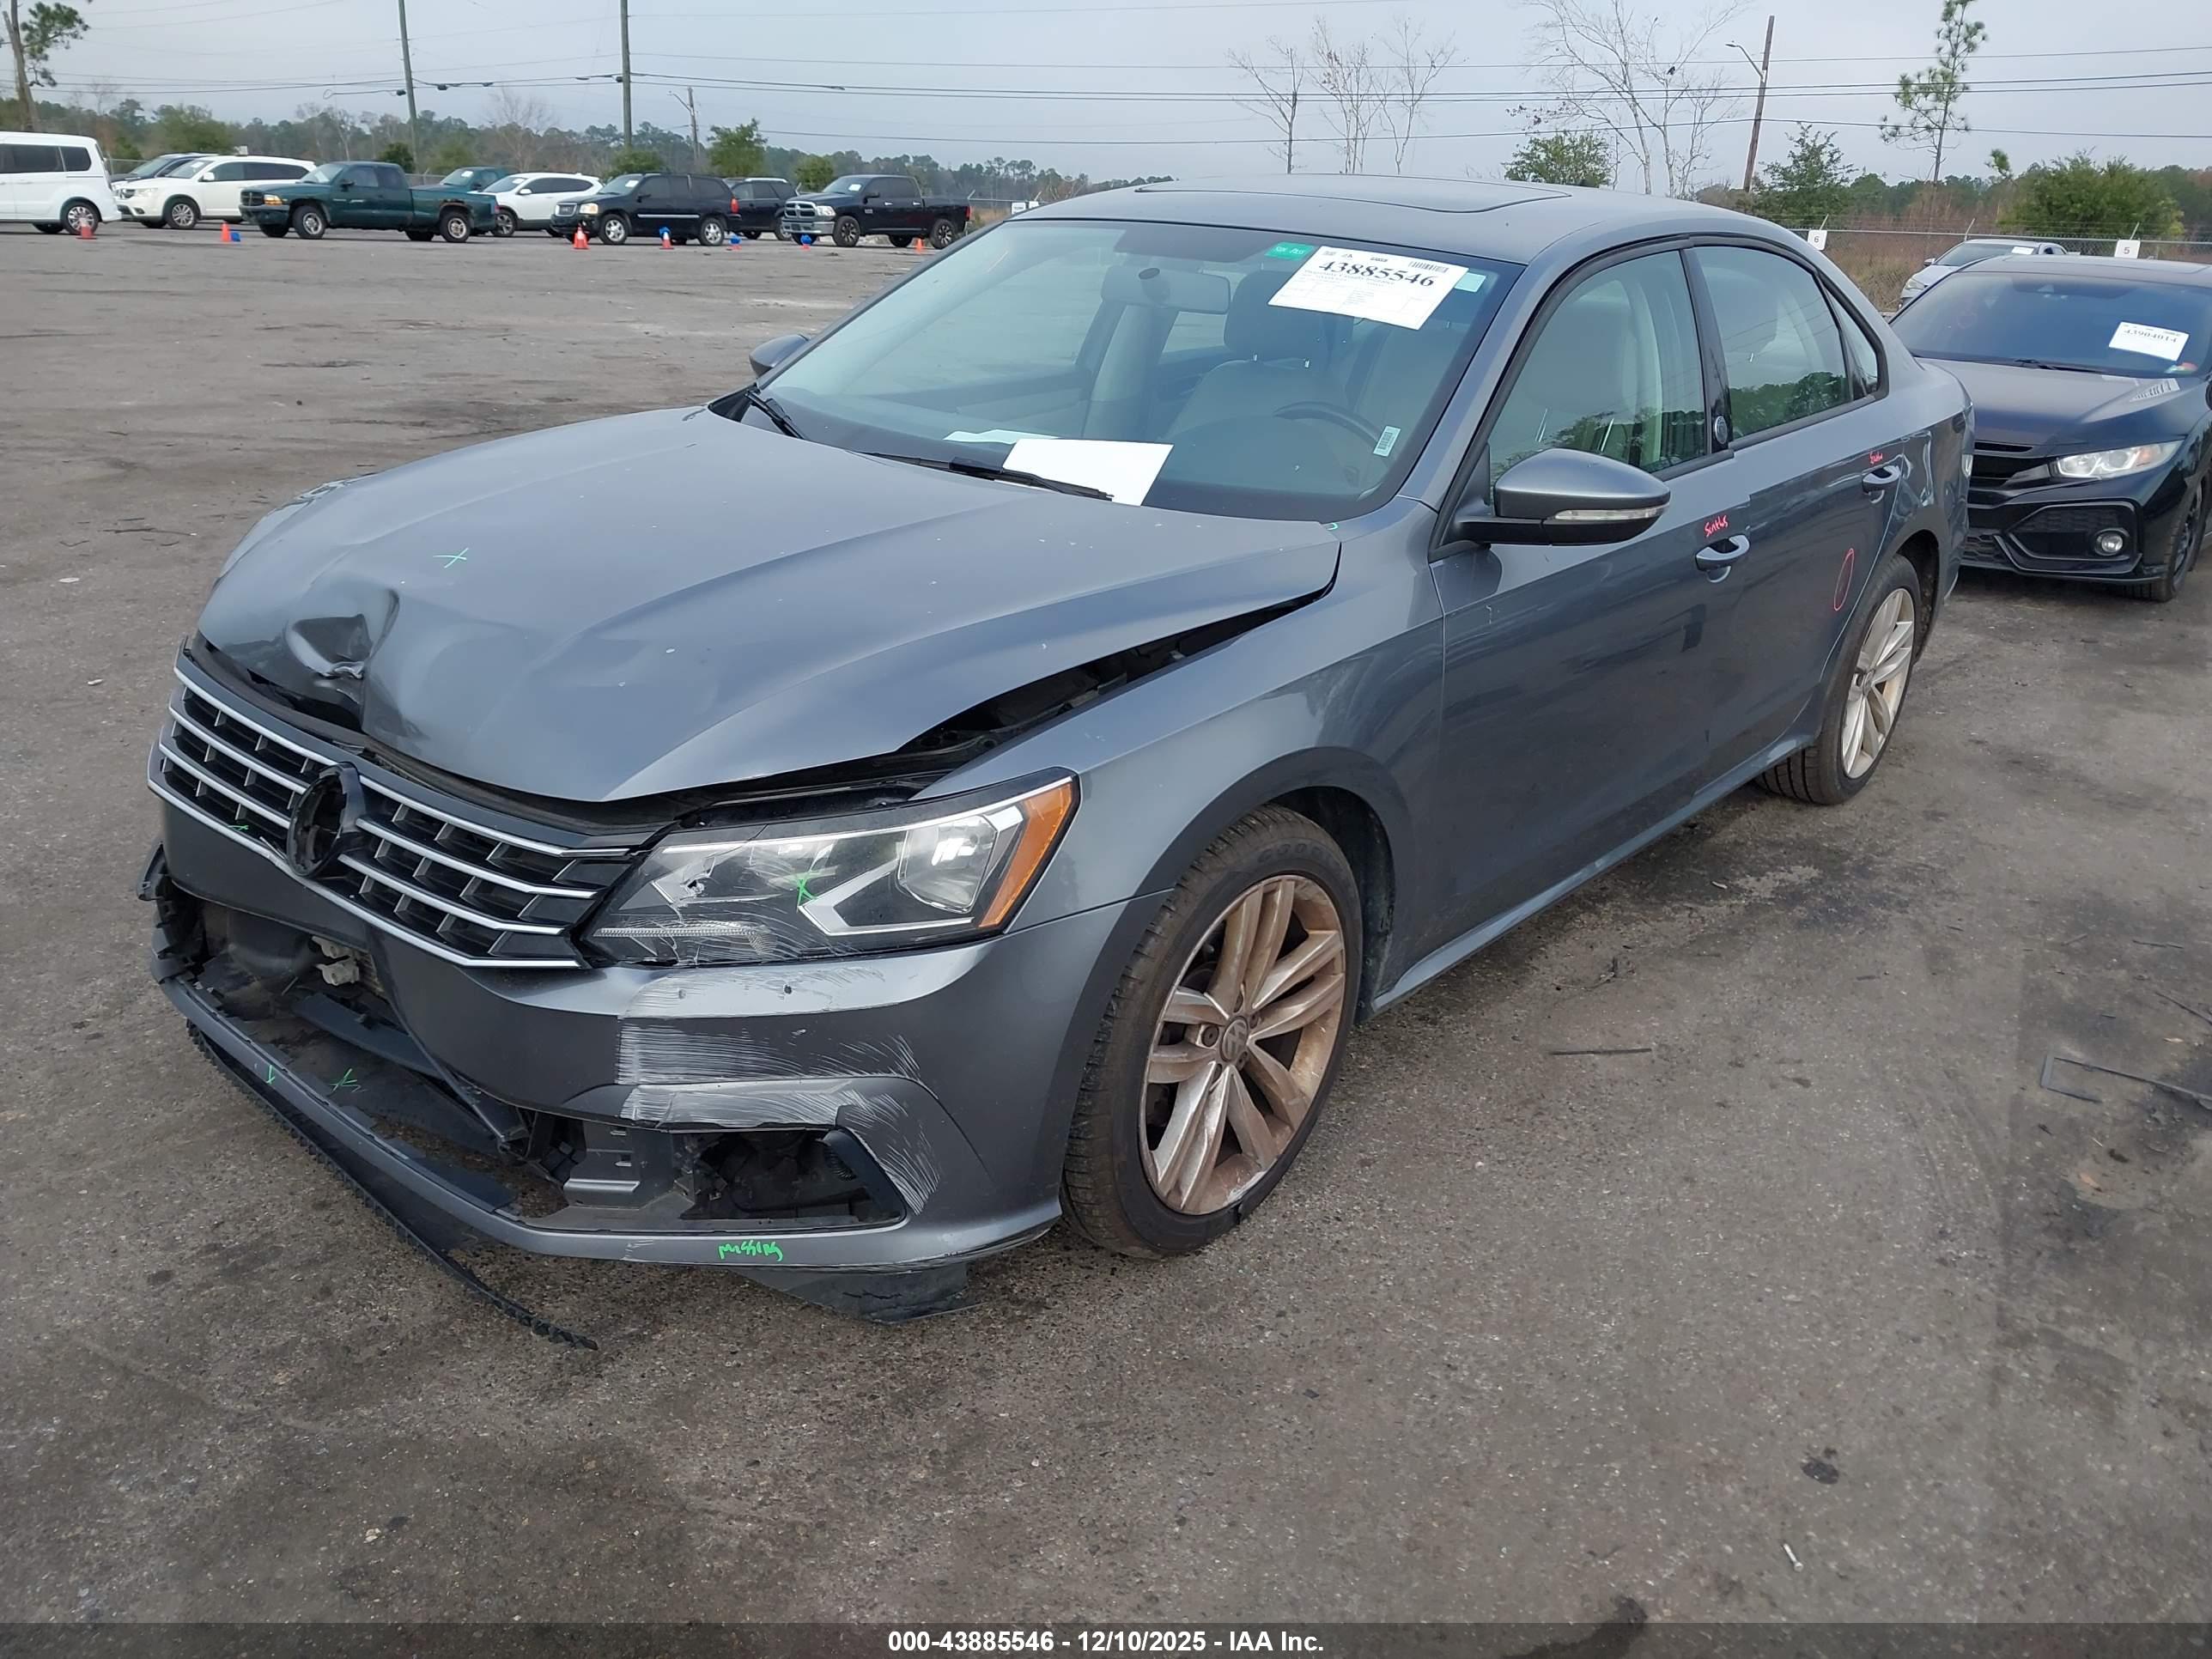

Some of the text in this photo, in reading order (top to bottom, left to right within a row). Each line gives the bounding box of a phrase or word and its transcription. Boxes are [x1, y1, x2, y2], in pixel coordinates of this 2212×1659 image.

[2124, 246, 2130, 255] 5
[1319, 260, 1437, 287] 43885546
[2124, 329, 2178, 343] 43904014
